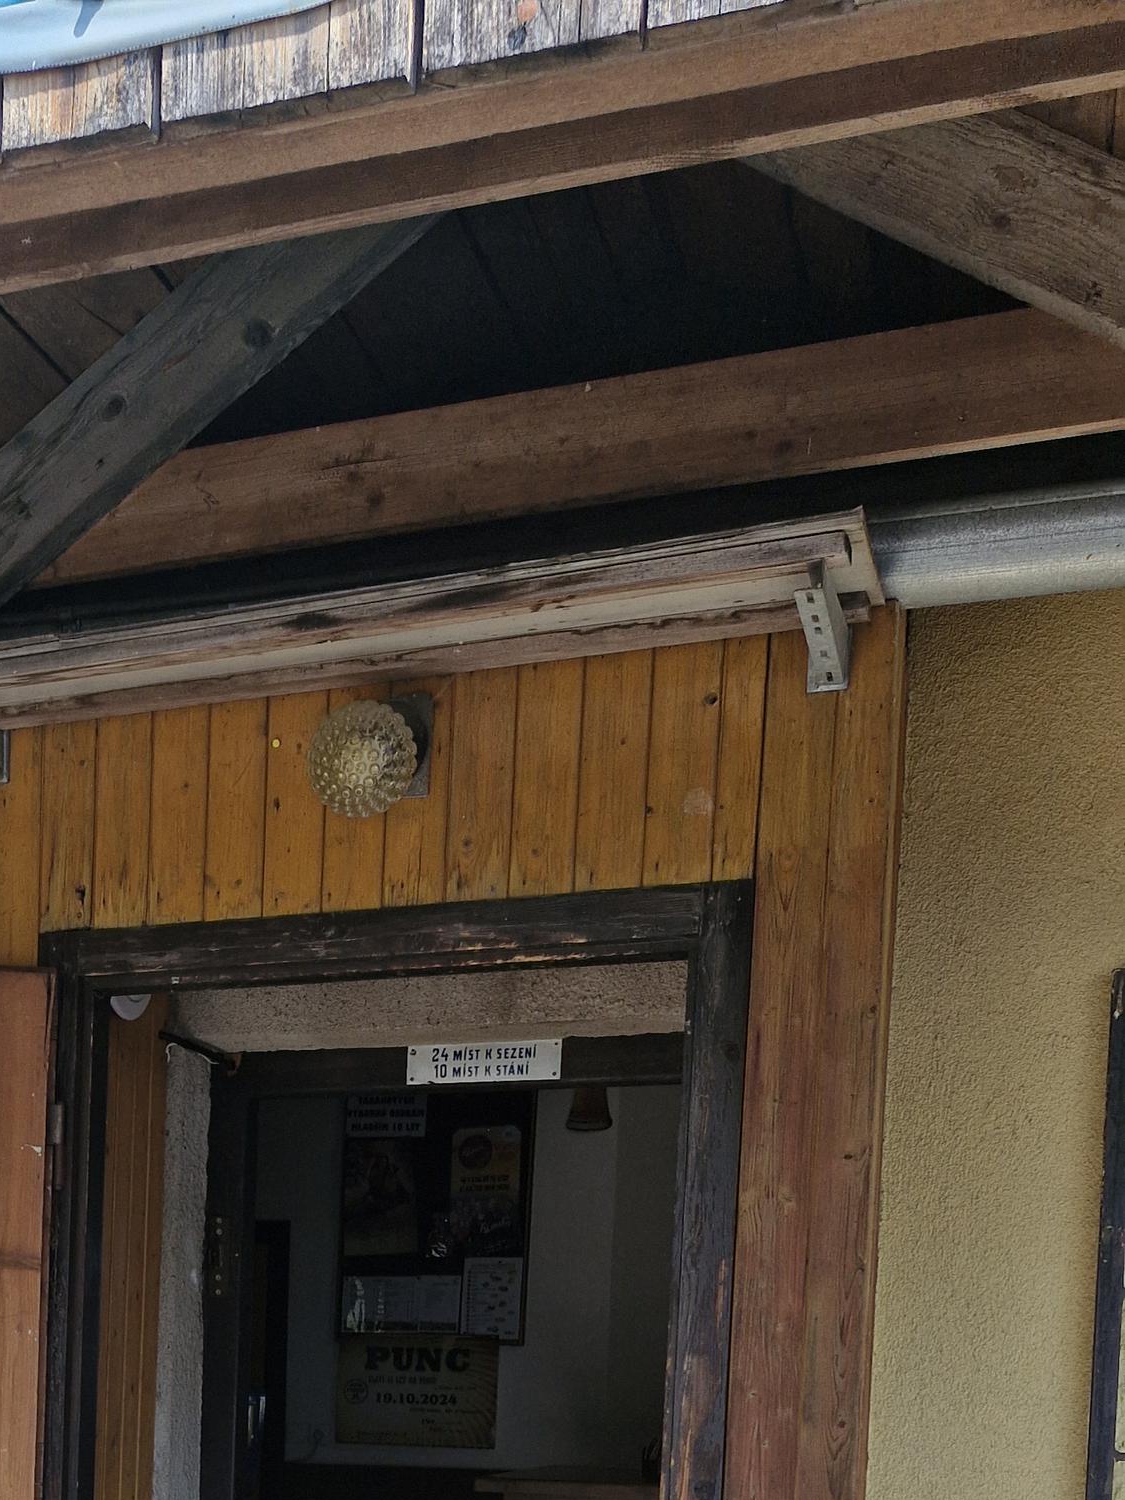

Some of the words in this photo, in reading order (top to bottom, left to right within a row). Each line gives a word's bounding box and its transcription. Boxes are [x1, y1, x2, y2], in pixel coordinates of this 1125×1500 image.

[432, 1047, 449, 1062] 24
[453, 1046, 481, 1061] MÍST
[485, 1047, 493, 1060] K
[496, 1044, 537, 1060] SEZENÍ
[434, 1063, 447, 1078] 10
[452, 1063, 480, 1077] MÍST
[484, 1065, 492, 1077] K
[496, 1061, 530, 1076] STÁNÍ
[376, 1392, 457, 1406] 19.10.2024
